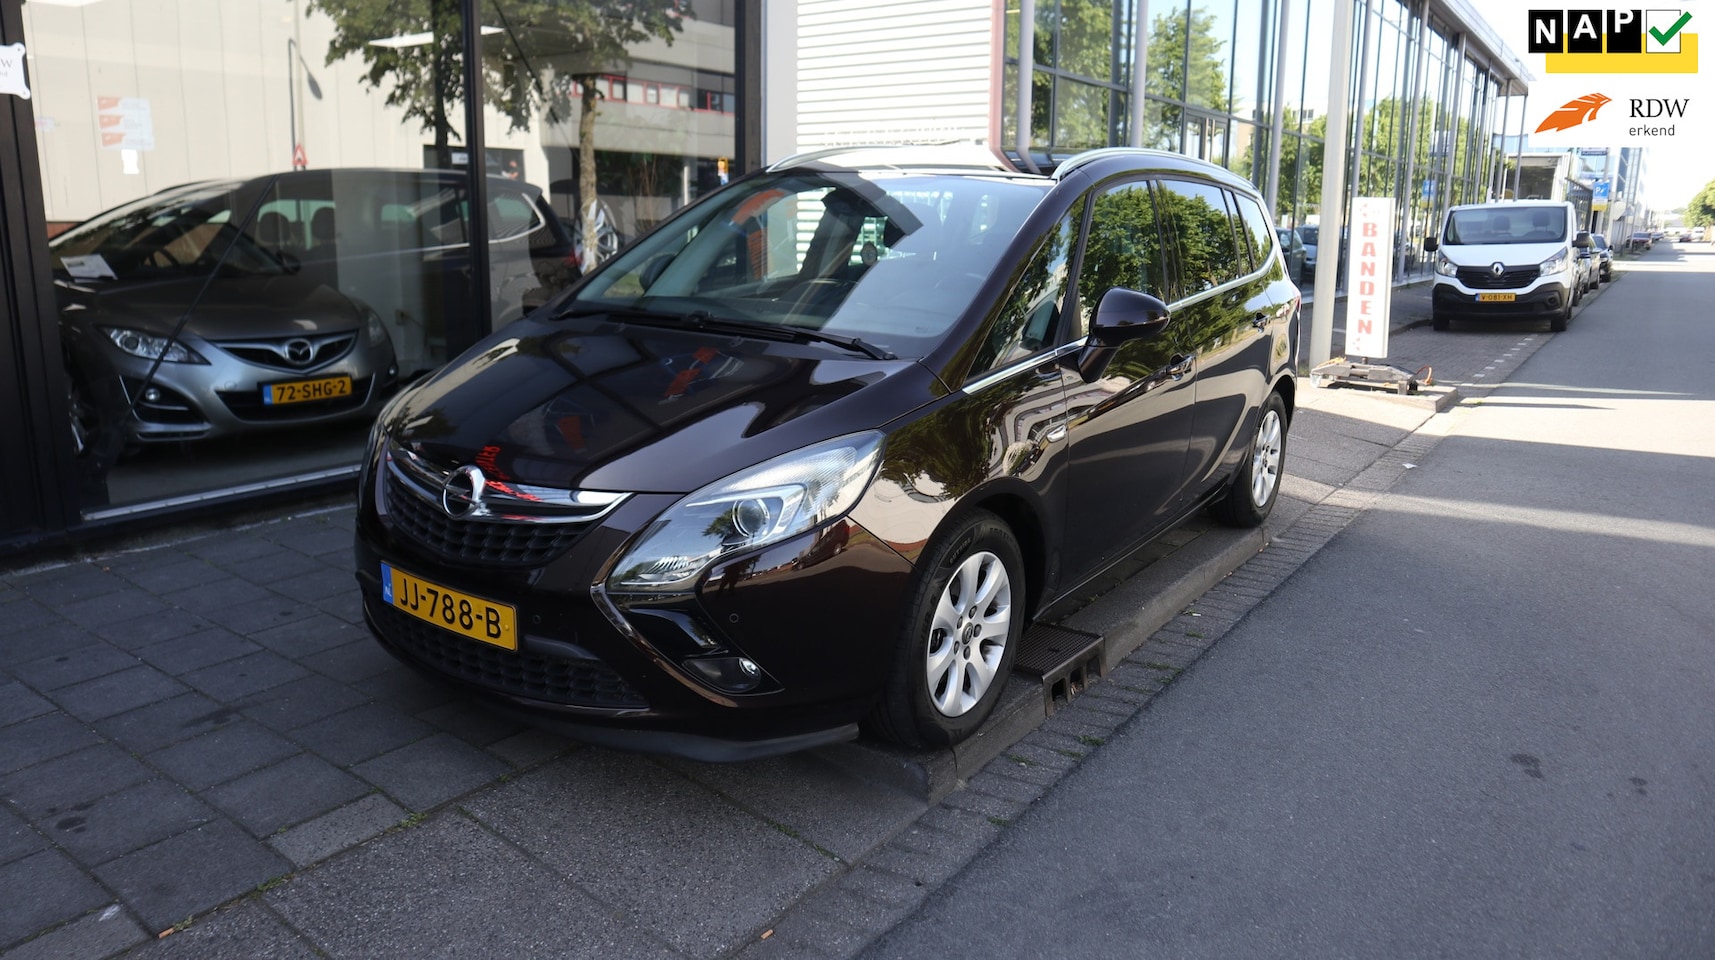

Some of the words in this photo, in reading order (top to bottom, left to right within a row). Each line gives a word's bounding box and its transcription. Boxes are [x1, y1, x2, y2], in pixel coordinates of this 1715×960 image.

[1357, 222, 1378, 335] BANDEN
[276, 380, 346, 401] 72-SHG-2
[400, 578, 501, 638] JJ-788-B
